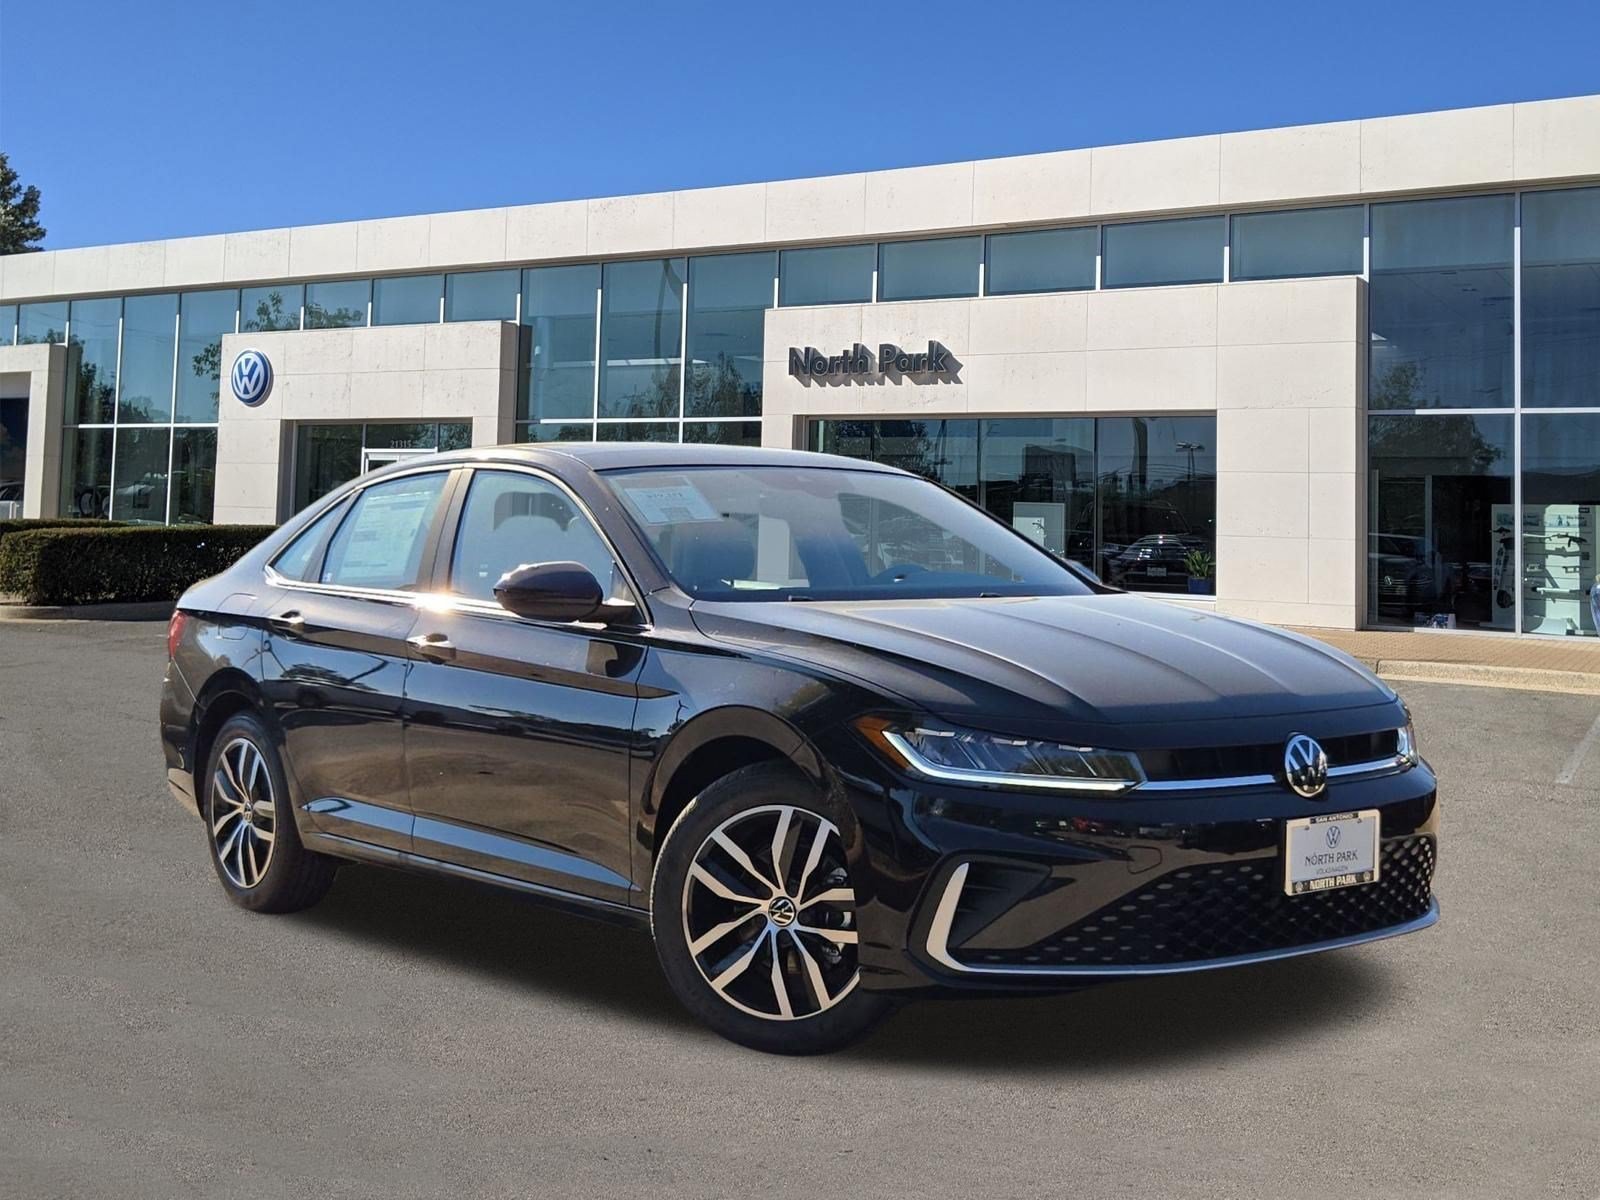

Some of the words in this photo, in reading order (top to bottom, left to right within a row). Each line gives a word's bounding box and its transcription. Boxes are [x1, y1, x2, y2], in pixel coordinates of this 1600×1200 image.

[788, 342, 874, 377] North
[878, 340, 947, 374] Park
[232, 351, 268, 402] VW
[390, 439, 412, 448] 21315
[1315, 816, 1328, 824] SAN
[1328, 813, 1354, 822] ANTONIO
[1304, 852, 1335, 867] NORTH
[1336, 849, 1359, 862] PARK
[1309, 877, 1336, 890] NORTH
[1336, 874, 1357, 886] PARK
